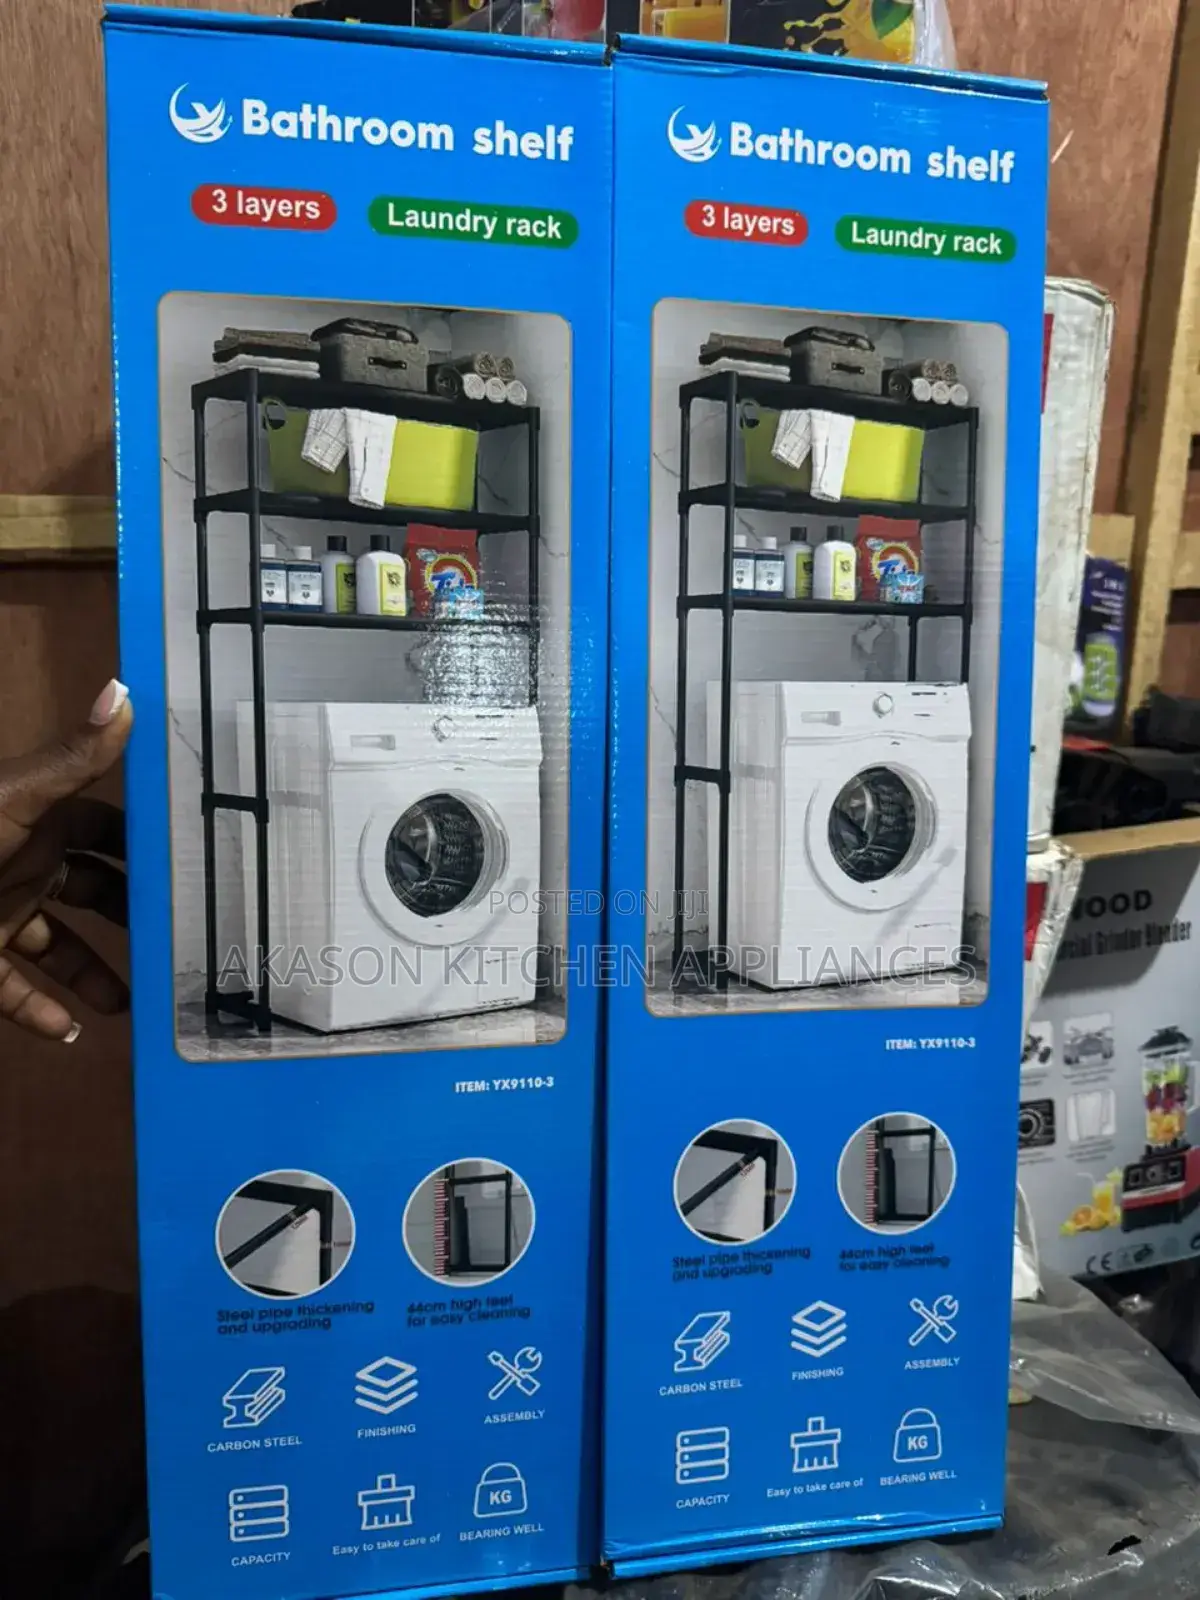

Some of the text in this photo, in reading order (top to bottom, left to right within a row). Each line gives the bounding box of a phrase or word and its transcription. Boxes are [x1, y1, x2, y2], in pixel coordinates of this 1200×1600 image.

[242, 98, 574, 161] Bathroom shelf
[730, 122, 1014, 183] Bathroom shelf
[211, 189, 321, 222] 3 layers
[388, 203, 562, 239] Laundry rack
[701, 205, 795, 236] 3 layers
[852, 222, 1002, 255] Laundry rack
[885, 1037, 976, 1050] ITEM: YX9110-3
[455, 1076, 554, 1093] ITEM: YX9110-3
[702, 1263, 772, 1278] upgrading
[216, 1300, 375, 1323] Steel pipe thickening
[451, 1298, 482, 1312] high
[217, 1317, 331, 1335] and upgrading
[431, 1314, 464, 1327] easy
[904, 1357, 960, 1370] ASSEMBLY
[792, 1367, 844, 1381] FINISHING
[659, 1379, 743, 1396] CARBON STEEL
[484, 1410, 545, 1425] ASSEMBLY
[357, 1424, 417, 1438] FINISHING
[207, 1436, 303, 1452] CARBON STEEL
[907, 1435, 928, 1450] KG
[880, 1469, 958, 1486] BEARING WELL
[766, 1477, 863, 1499] Easy to take care of
[489, 1490, 512, 1505] KG
[676, 1494, 730, 1509] CAPACITY
[459, 1523, 545, 1541] BEARING WELL
[332, 1533, 441, 1556] Easy to take care of
[231, 1552, 291, 1567] CAPACITY
